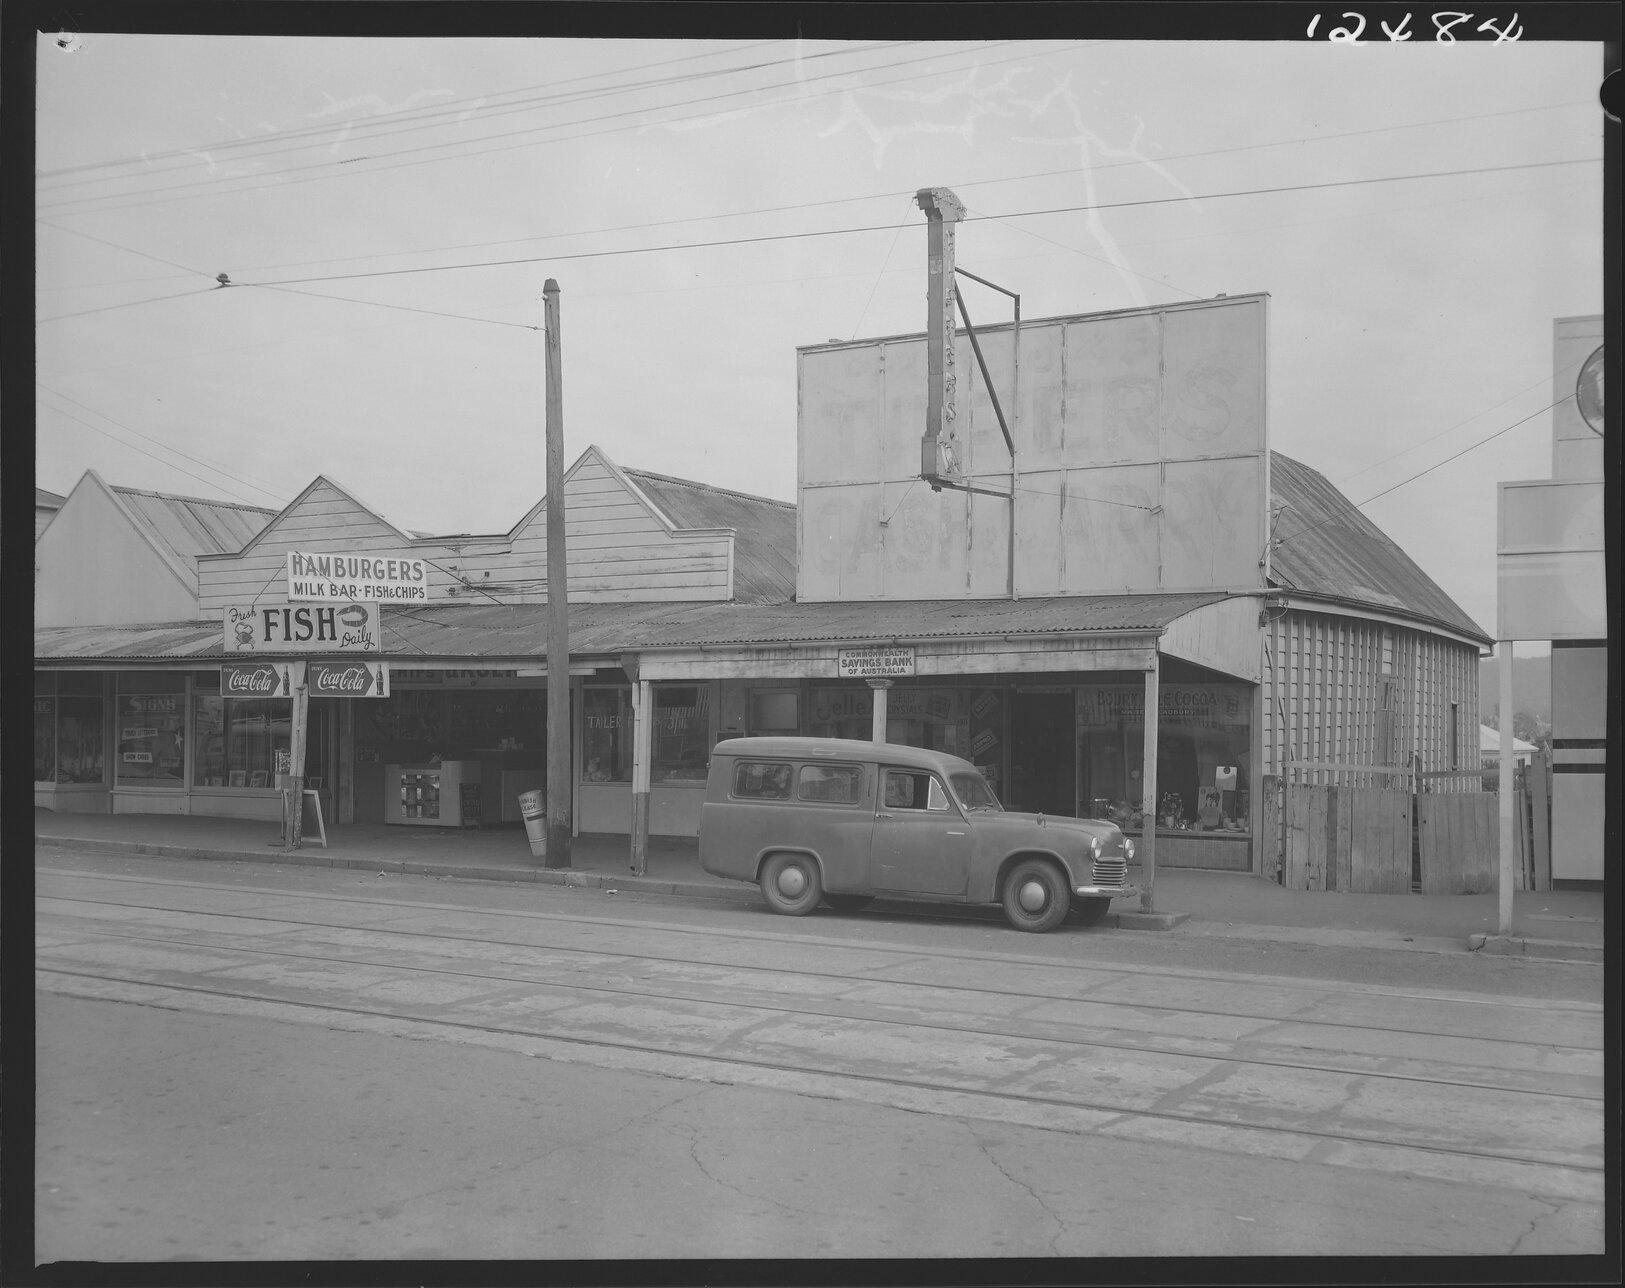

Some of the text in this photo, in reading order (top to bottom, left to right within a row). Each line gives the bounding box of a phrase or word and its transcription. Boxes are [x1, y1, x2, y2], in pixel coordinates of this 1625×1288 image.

[291, 554, 424, 582] HAMBURGERS
[293, 582, 325, 597] MILK
[228, 606, 257, 623] Fresh
[262, 607, 338, 642] FISH
[339, 624, 376, 651] Daily
[841, 657, 913, 669] SAVINGS BANK
[845, 650, 909, 659] COMMONWEALTH
[317, 667, 366, 691] Coca-Cola
[860, 667, 907, 675] AUSTRALIA
[228, 669, 274, 692] Coca-Cola
[1174, 690, 1218, 706] COCOA
